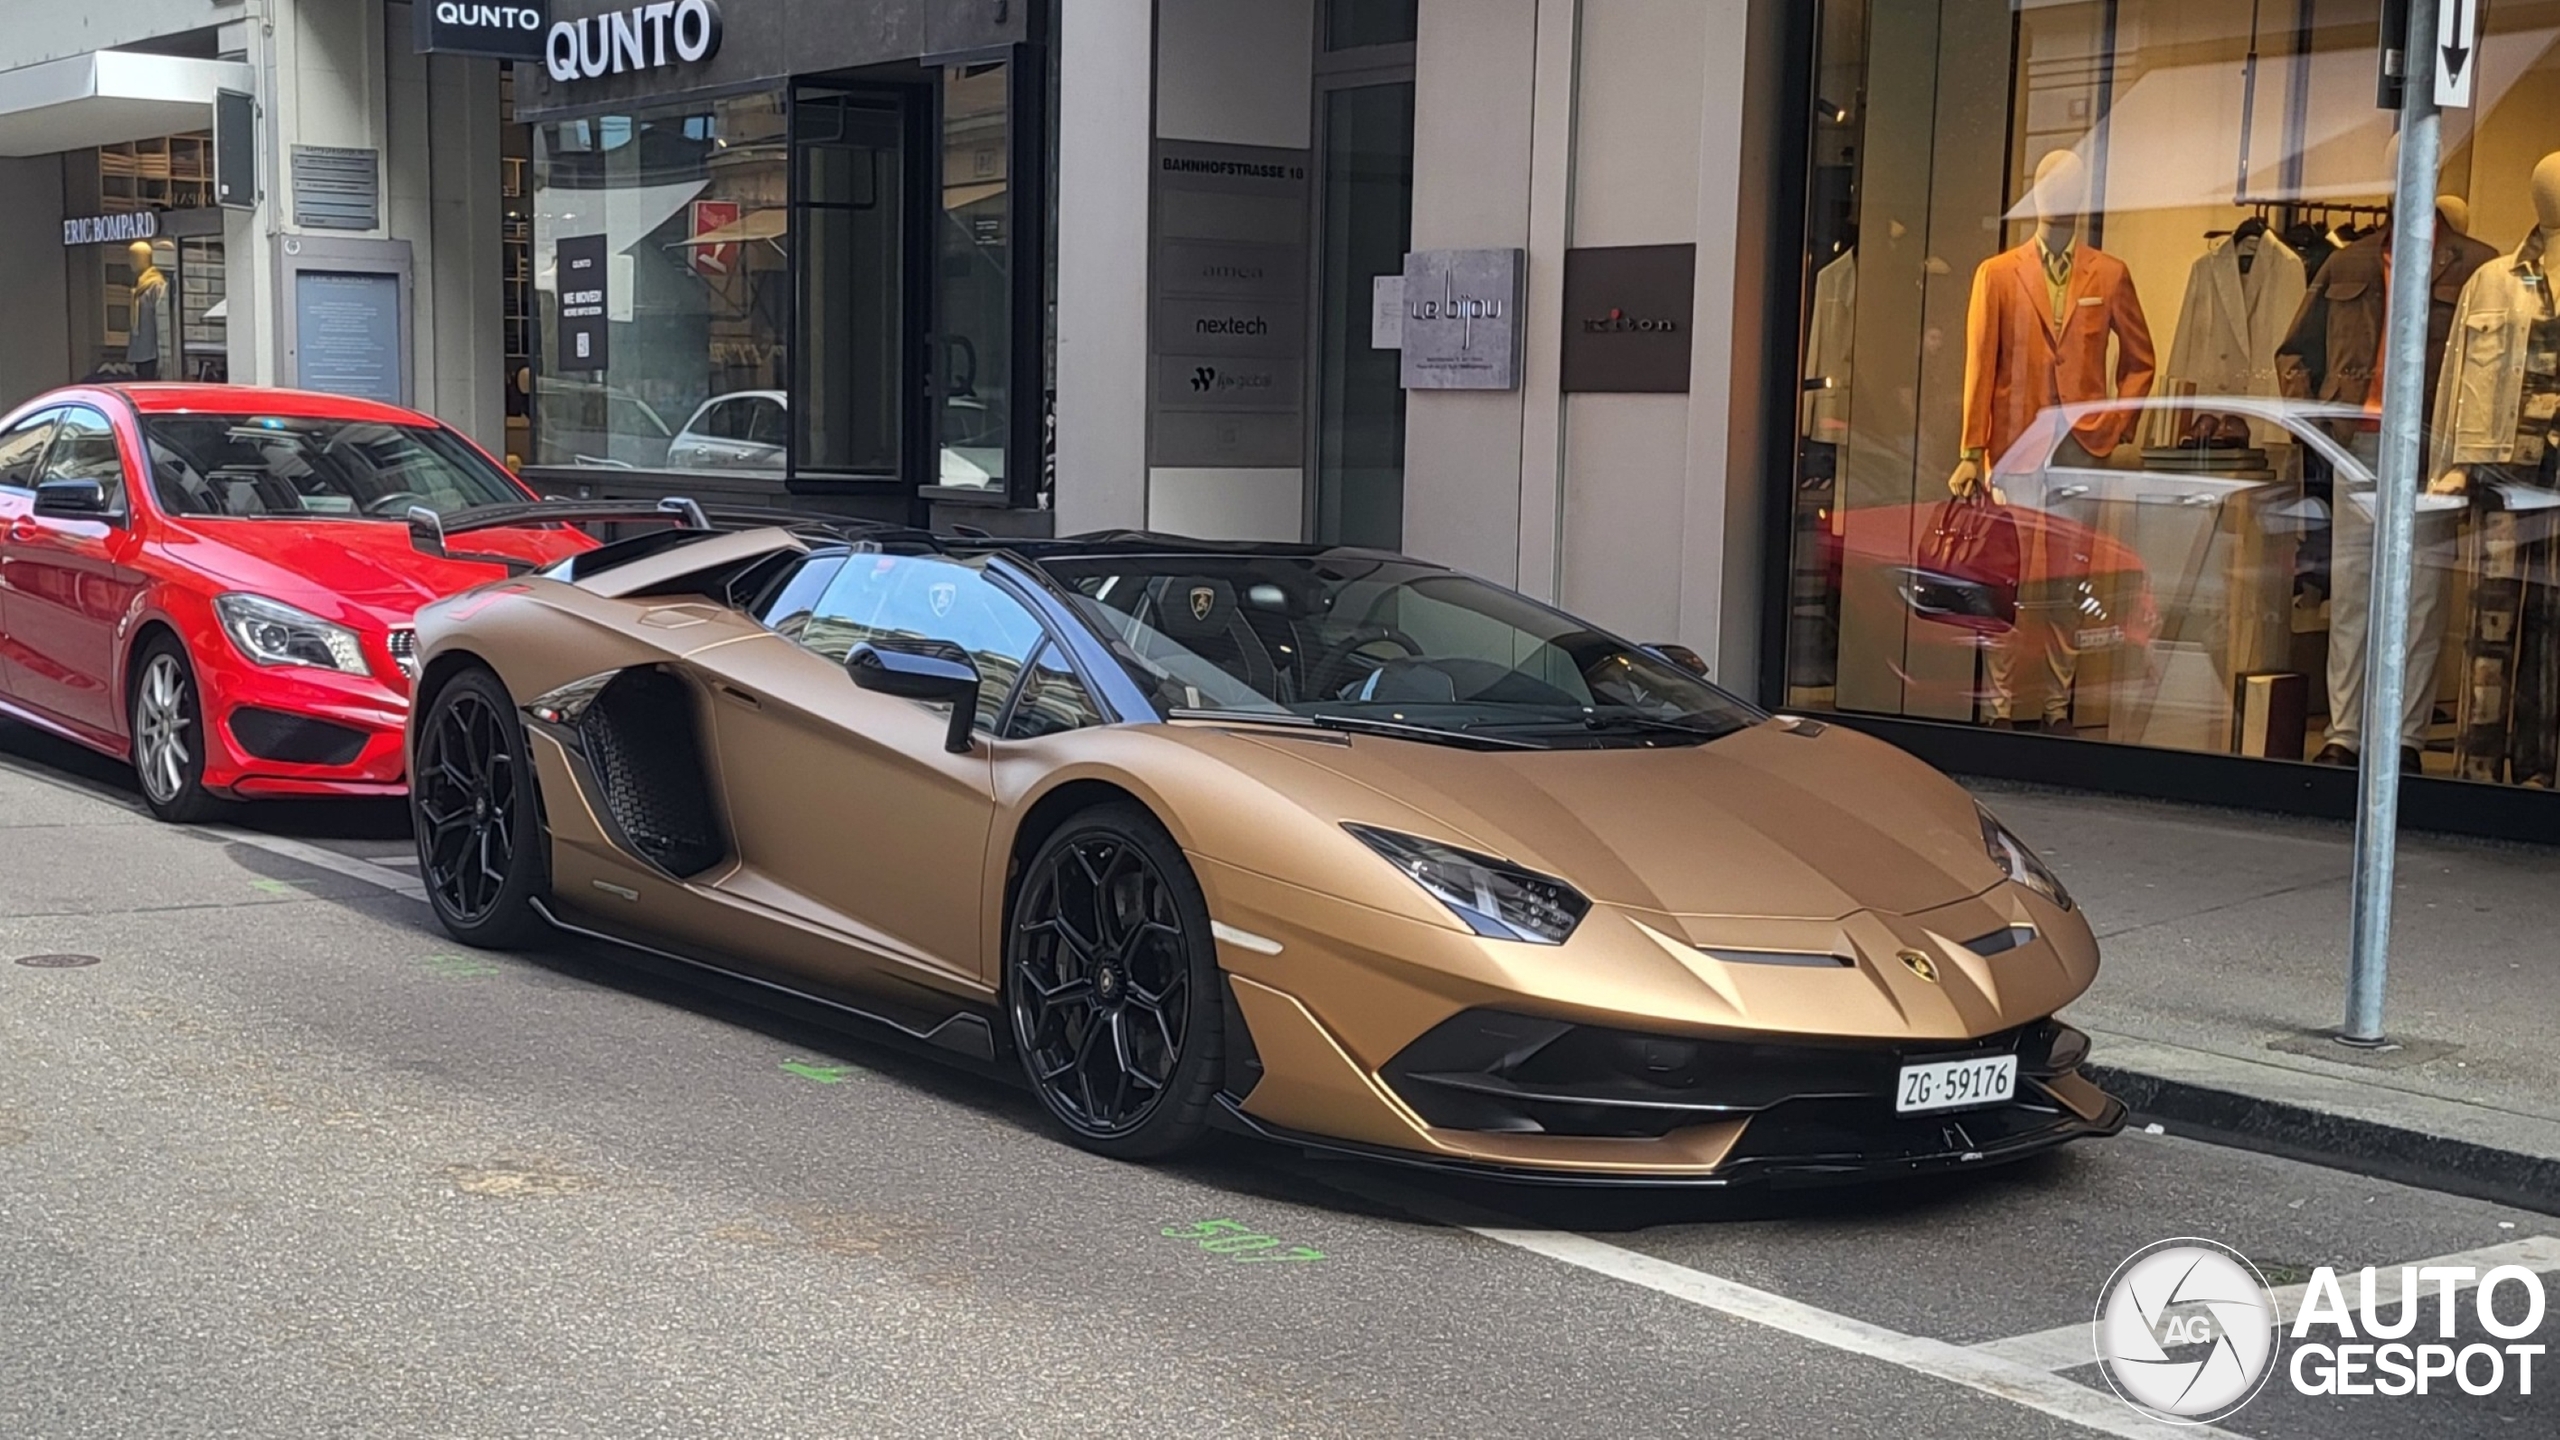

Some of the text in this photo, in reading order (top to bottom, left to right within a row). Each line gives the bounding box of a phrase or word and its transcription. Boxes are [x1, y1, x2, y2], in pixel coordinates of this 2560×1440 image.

[436, 2, 540, 30] QUNTO
[546, 0, 711, 82] QUNTO
[1163, 157, 1286, 178] BAHNHOFSTRASSE
[64, 211, 155, 245] ERIC BOMPARD
[1445, 269, 1501, 350] bijou
[1196, 316, 1267, 335] nextech
